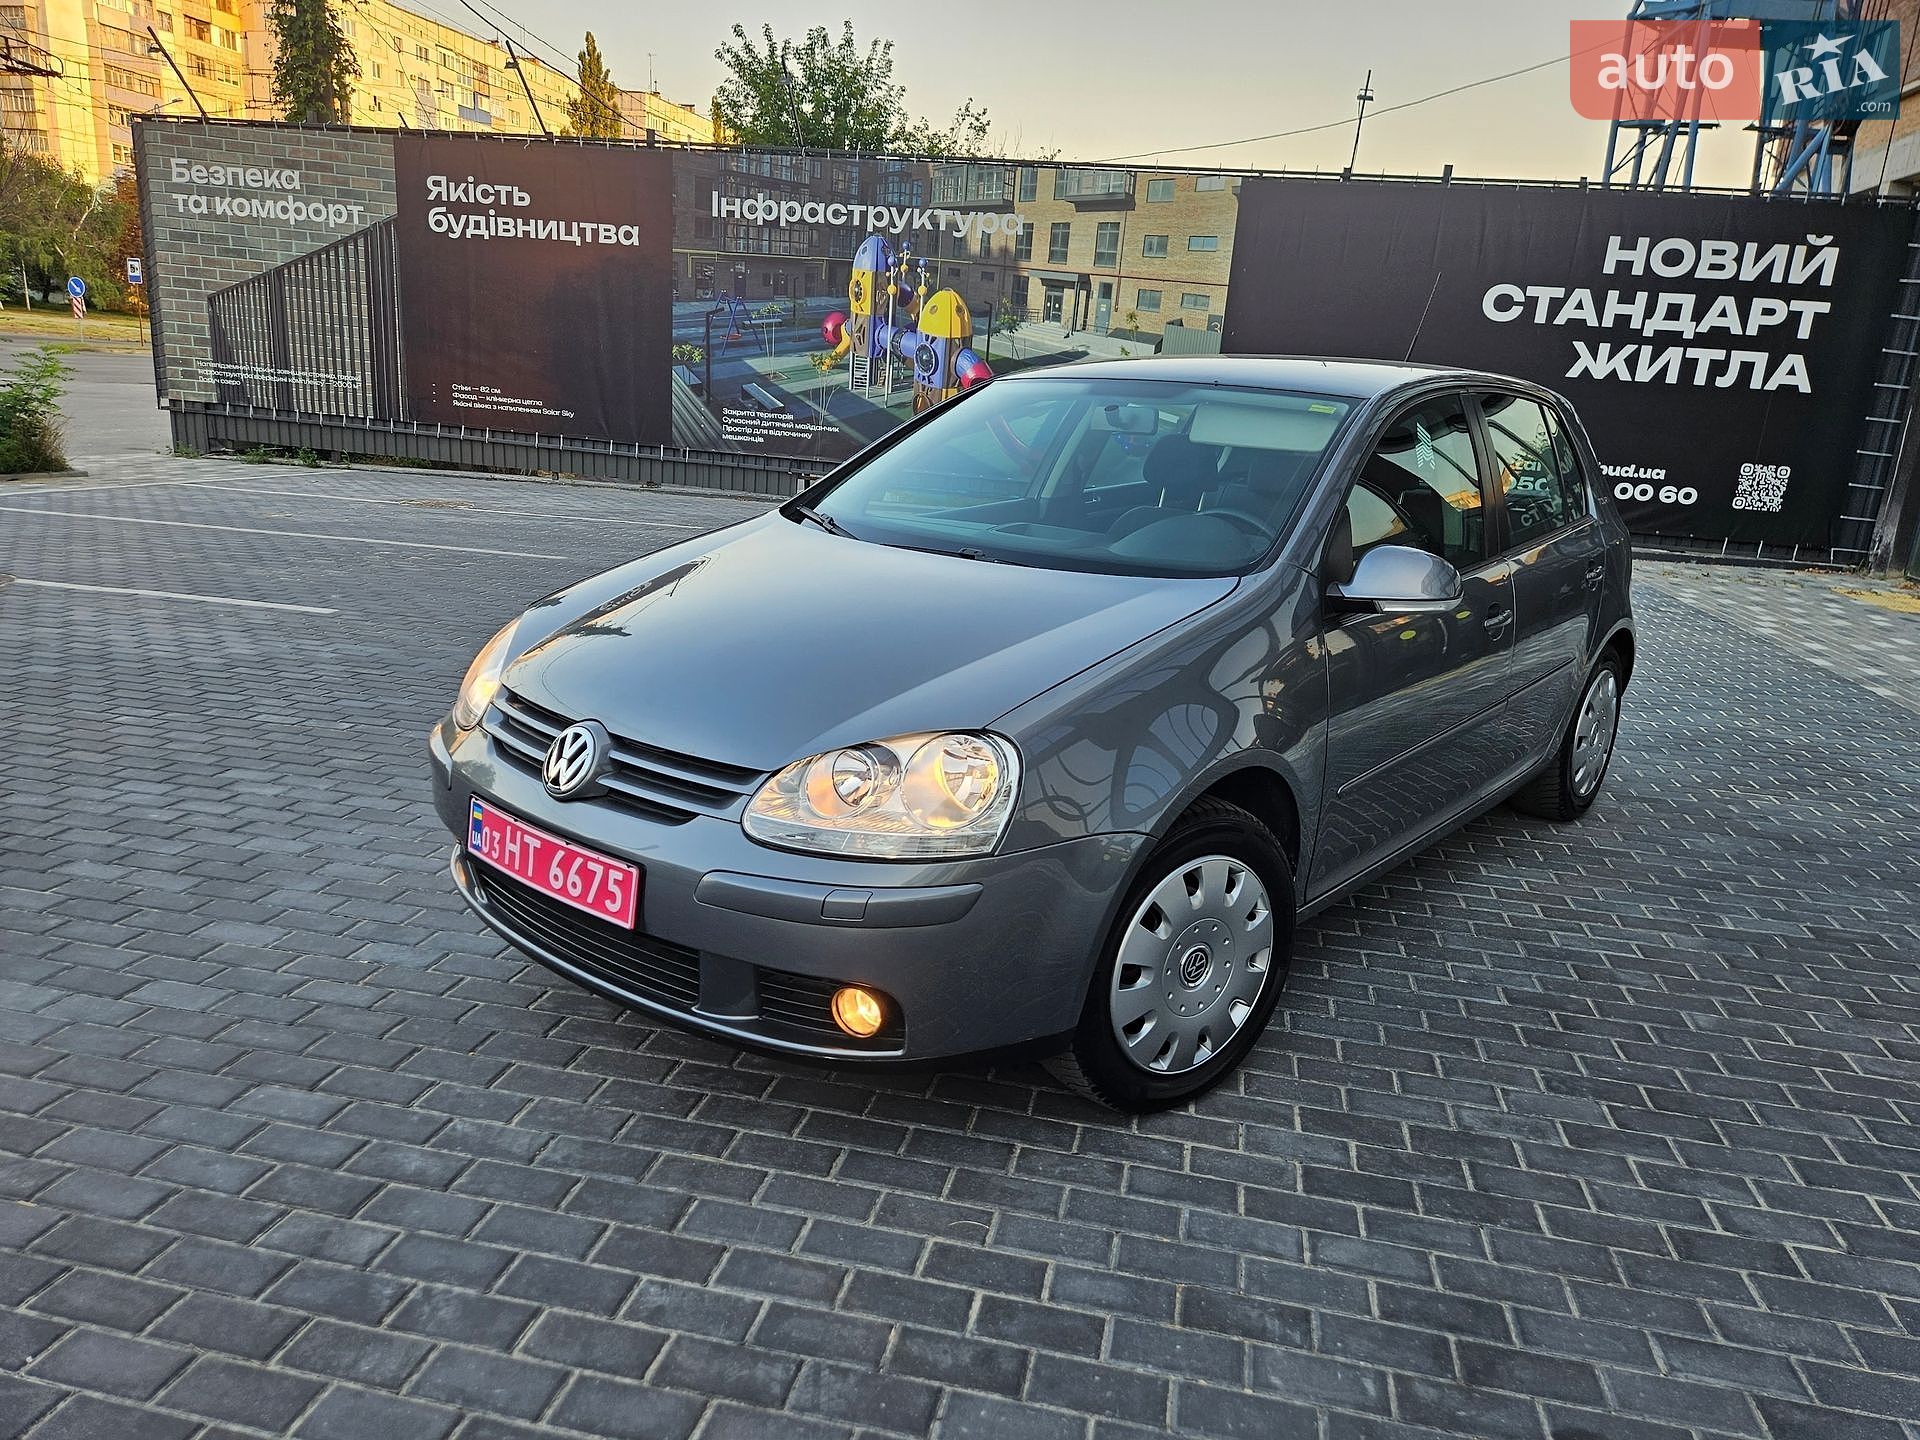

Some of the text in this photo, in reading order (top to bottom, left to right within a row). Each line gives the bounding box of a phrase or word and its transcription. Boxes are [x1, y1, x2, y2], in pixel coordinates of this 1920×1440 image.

[170, 157, 301, 190] Безпека
[426, 175, 531, 207] Якість
[172, 193, 364, 228] та комфорт
[711, 190, 1024, 238] Інфраструктура
[427, 206, 640, 246] будівництва
[1602, 234, 1840, 287] НОВИЙ
[1482, 283, 1831, 339] СТАНДАРТ
[1565, 341, 1812, 394] ЖИТЛА
[452, 383, 471, 392] Стіни
[480, 386, 490, 394] 82
[452, 392, 478, 400] Фасад
[486, 395, 521, 405] клінкерна
[522, 398, 543, 406] цегла
[453, 399, 472, 408] Якісні
[474, 402, 492, 410] вікна
[498, 405, 541, 414] напиленням
[542, 408, 560, 416] Solar
[561, 409, 575, 418] Sky
[722, 407, 794, 421] Закрита територія
[722, 416, 840, 433] Сучасний дитячий майданчик
[722, 425, 752, 434] Простір
[769, 428, 812, 440] відпочинку
[722, 433, 764, 443] мешканців
[1614, 482, 1654, 501] 00
[1658, 486, 1698, 505] 60
[472, 830, 482, 848] UA
[482, 826, 624, 913] 03 HT 6675
